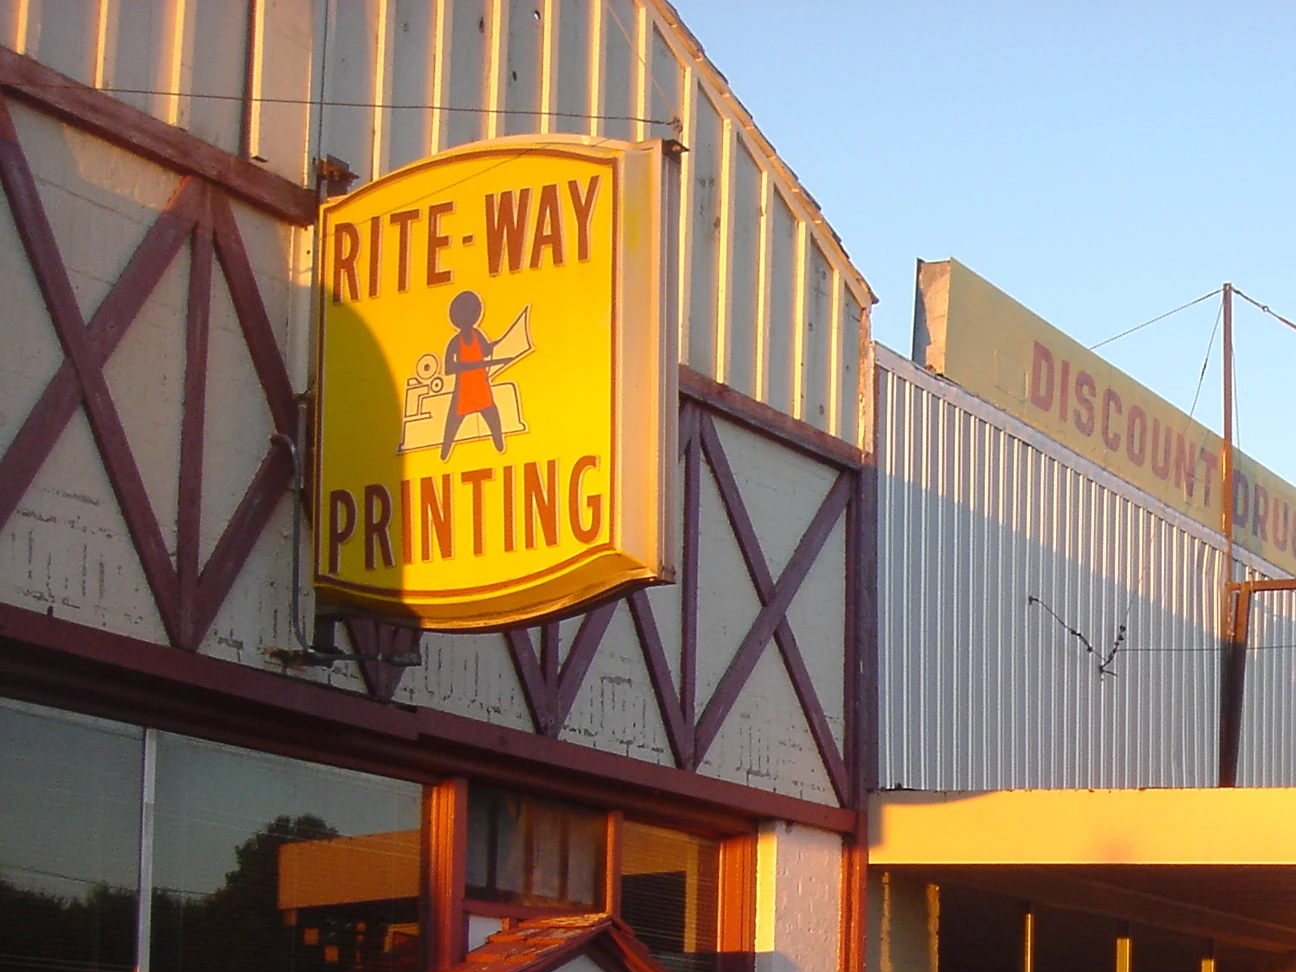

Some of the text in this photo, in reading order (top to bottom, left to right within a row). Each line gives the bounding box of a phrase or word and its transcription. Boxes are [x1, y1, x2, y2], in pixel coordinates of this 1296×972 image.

[331, 174, 602, 304] RITE-WAY
[1030, 340, 1218, 509] DISCOUNT
[327, 454, 604, 575] PRINTING
